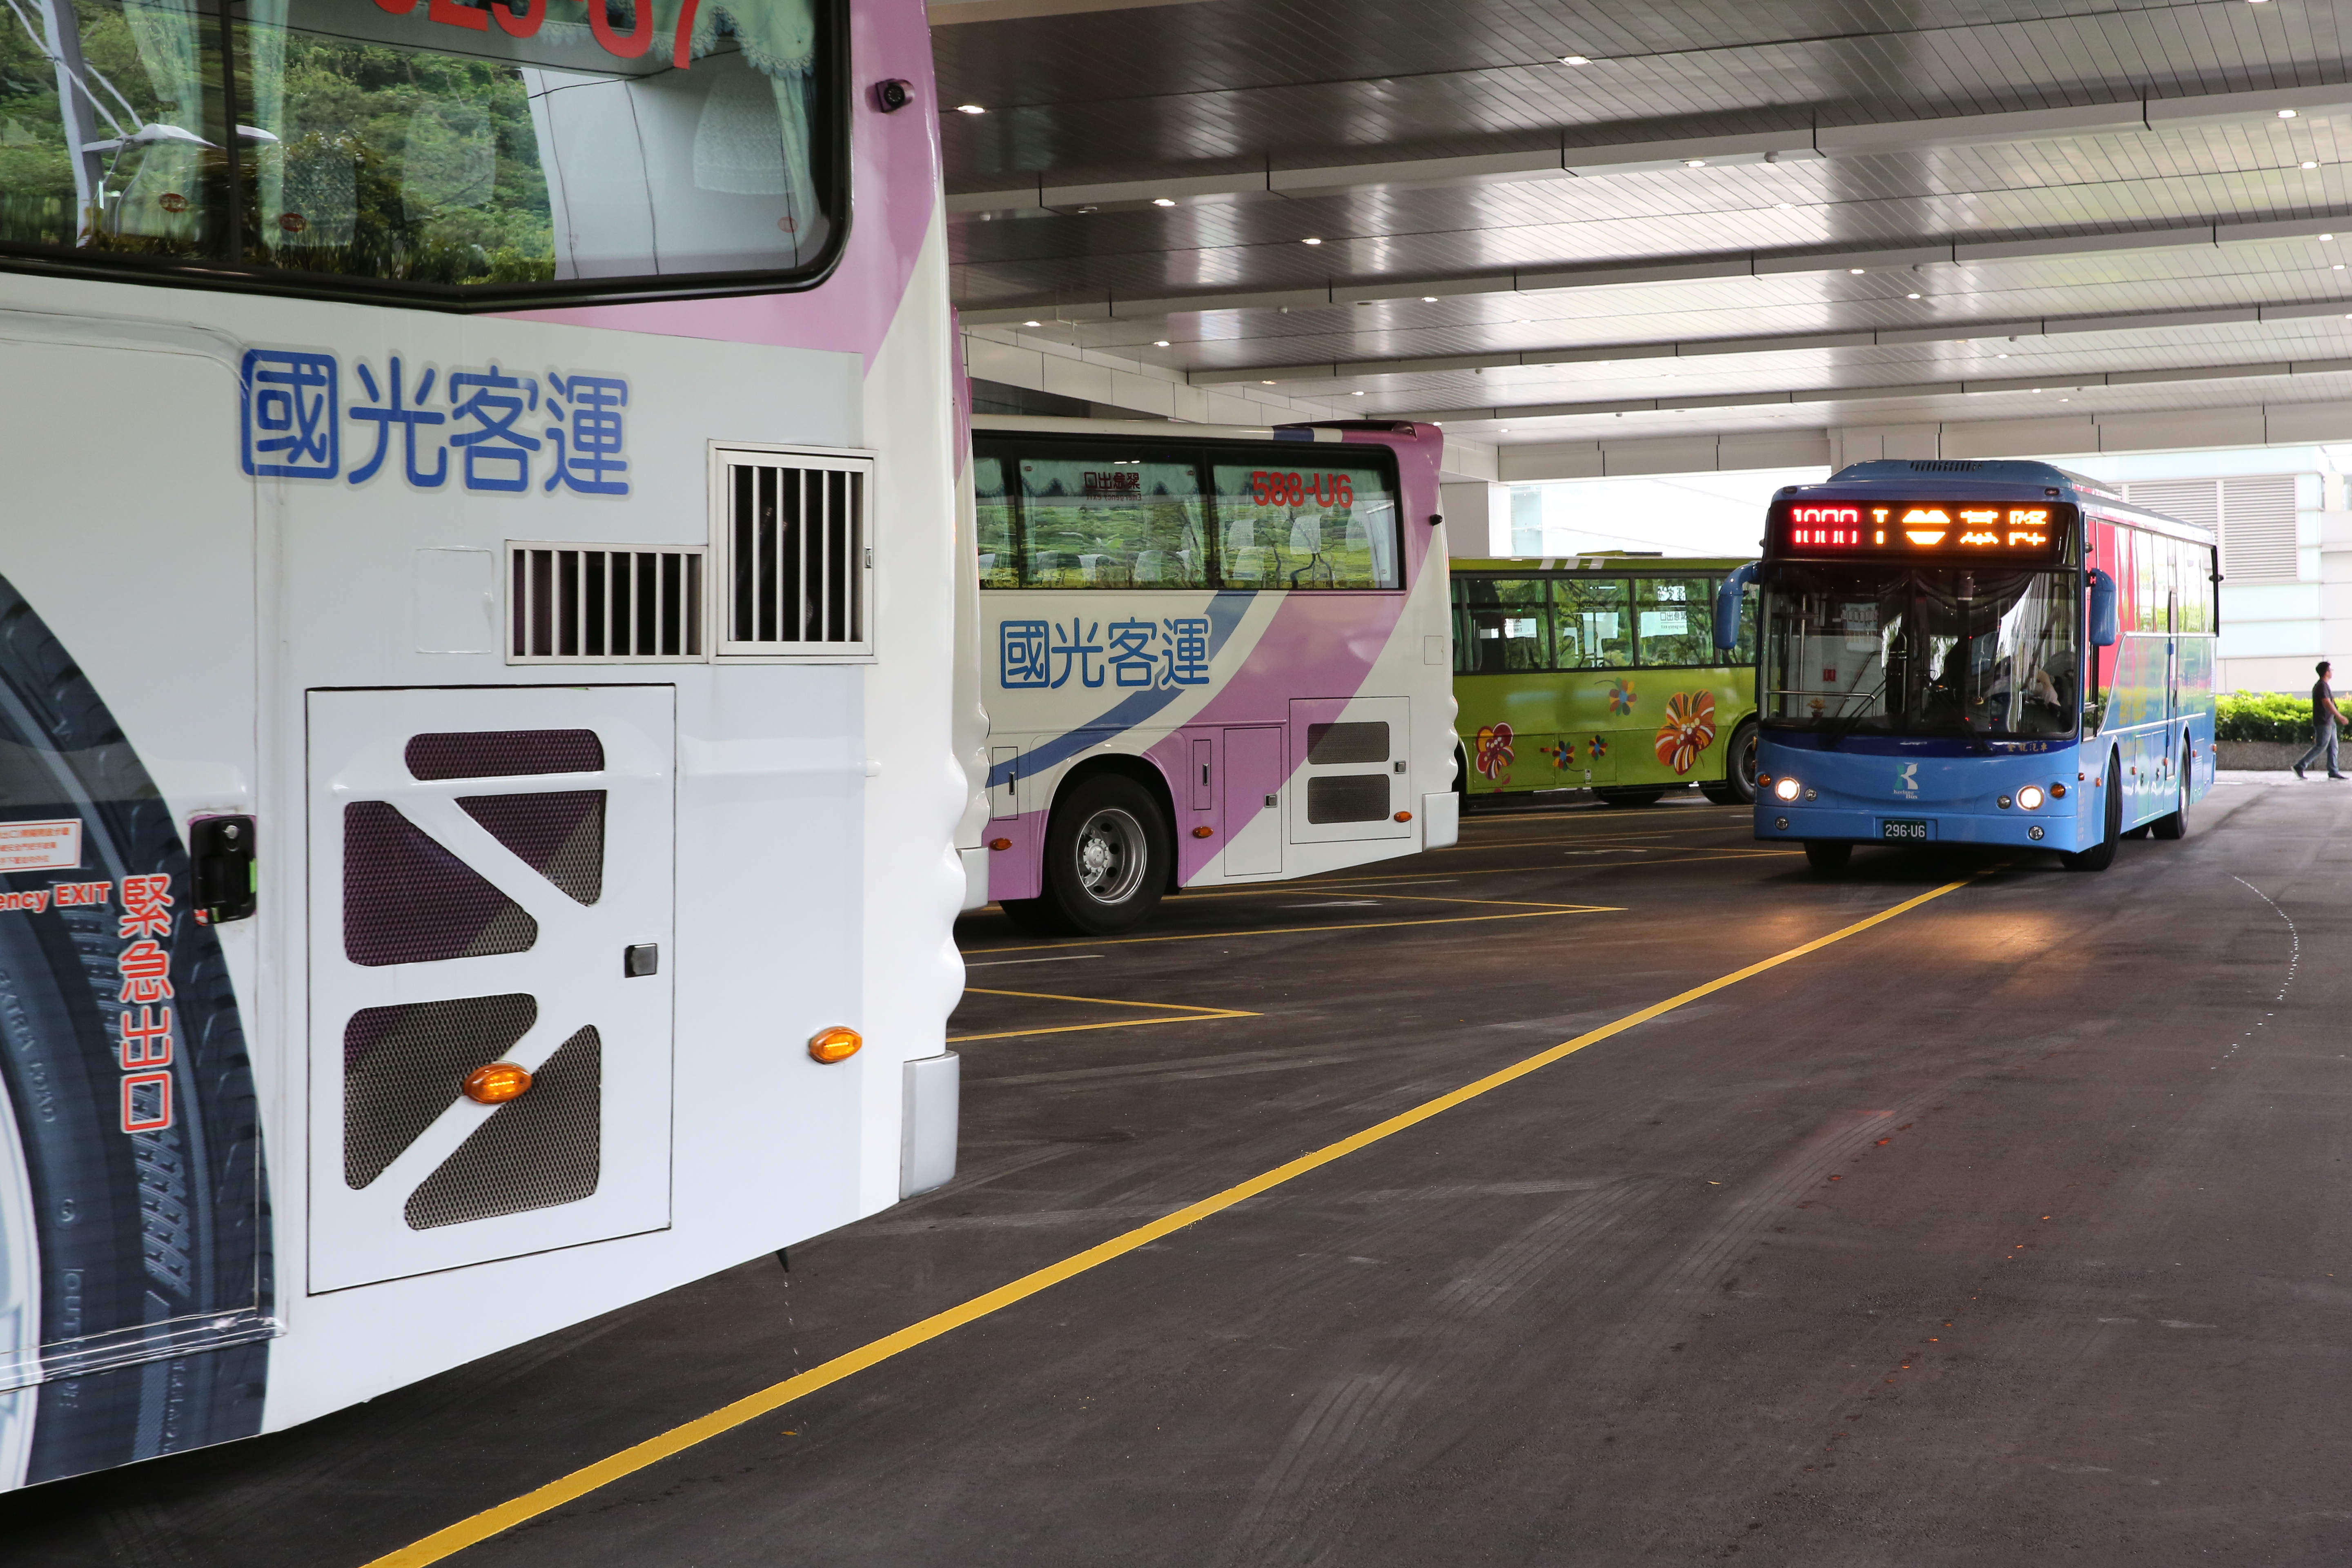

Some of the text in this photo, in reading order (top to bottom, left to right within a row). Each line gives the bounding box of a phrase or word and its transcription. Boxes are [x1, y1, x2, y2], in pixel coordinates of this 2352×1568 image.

[241, 349, 629, 495] 國光客運
[1253, 471, 1353, 508] 588-U6
[1000, 617, 1209, 688] 國光客運
[1885, 824, 1925, 837] 296-U6
[56, 883, 111, 905] EXIT
[119, 875, 173, 1132] 緊急出口
